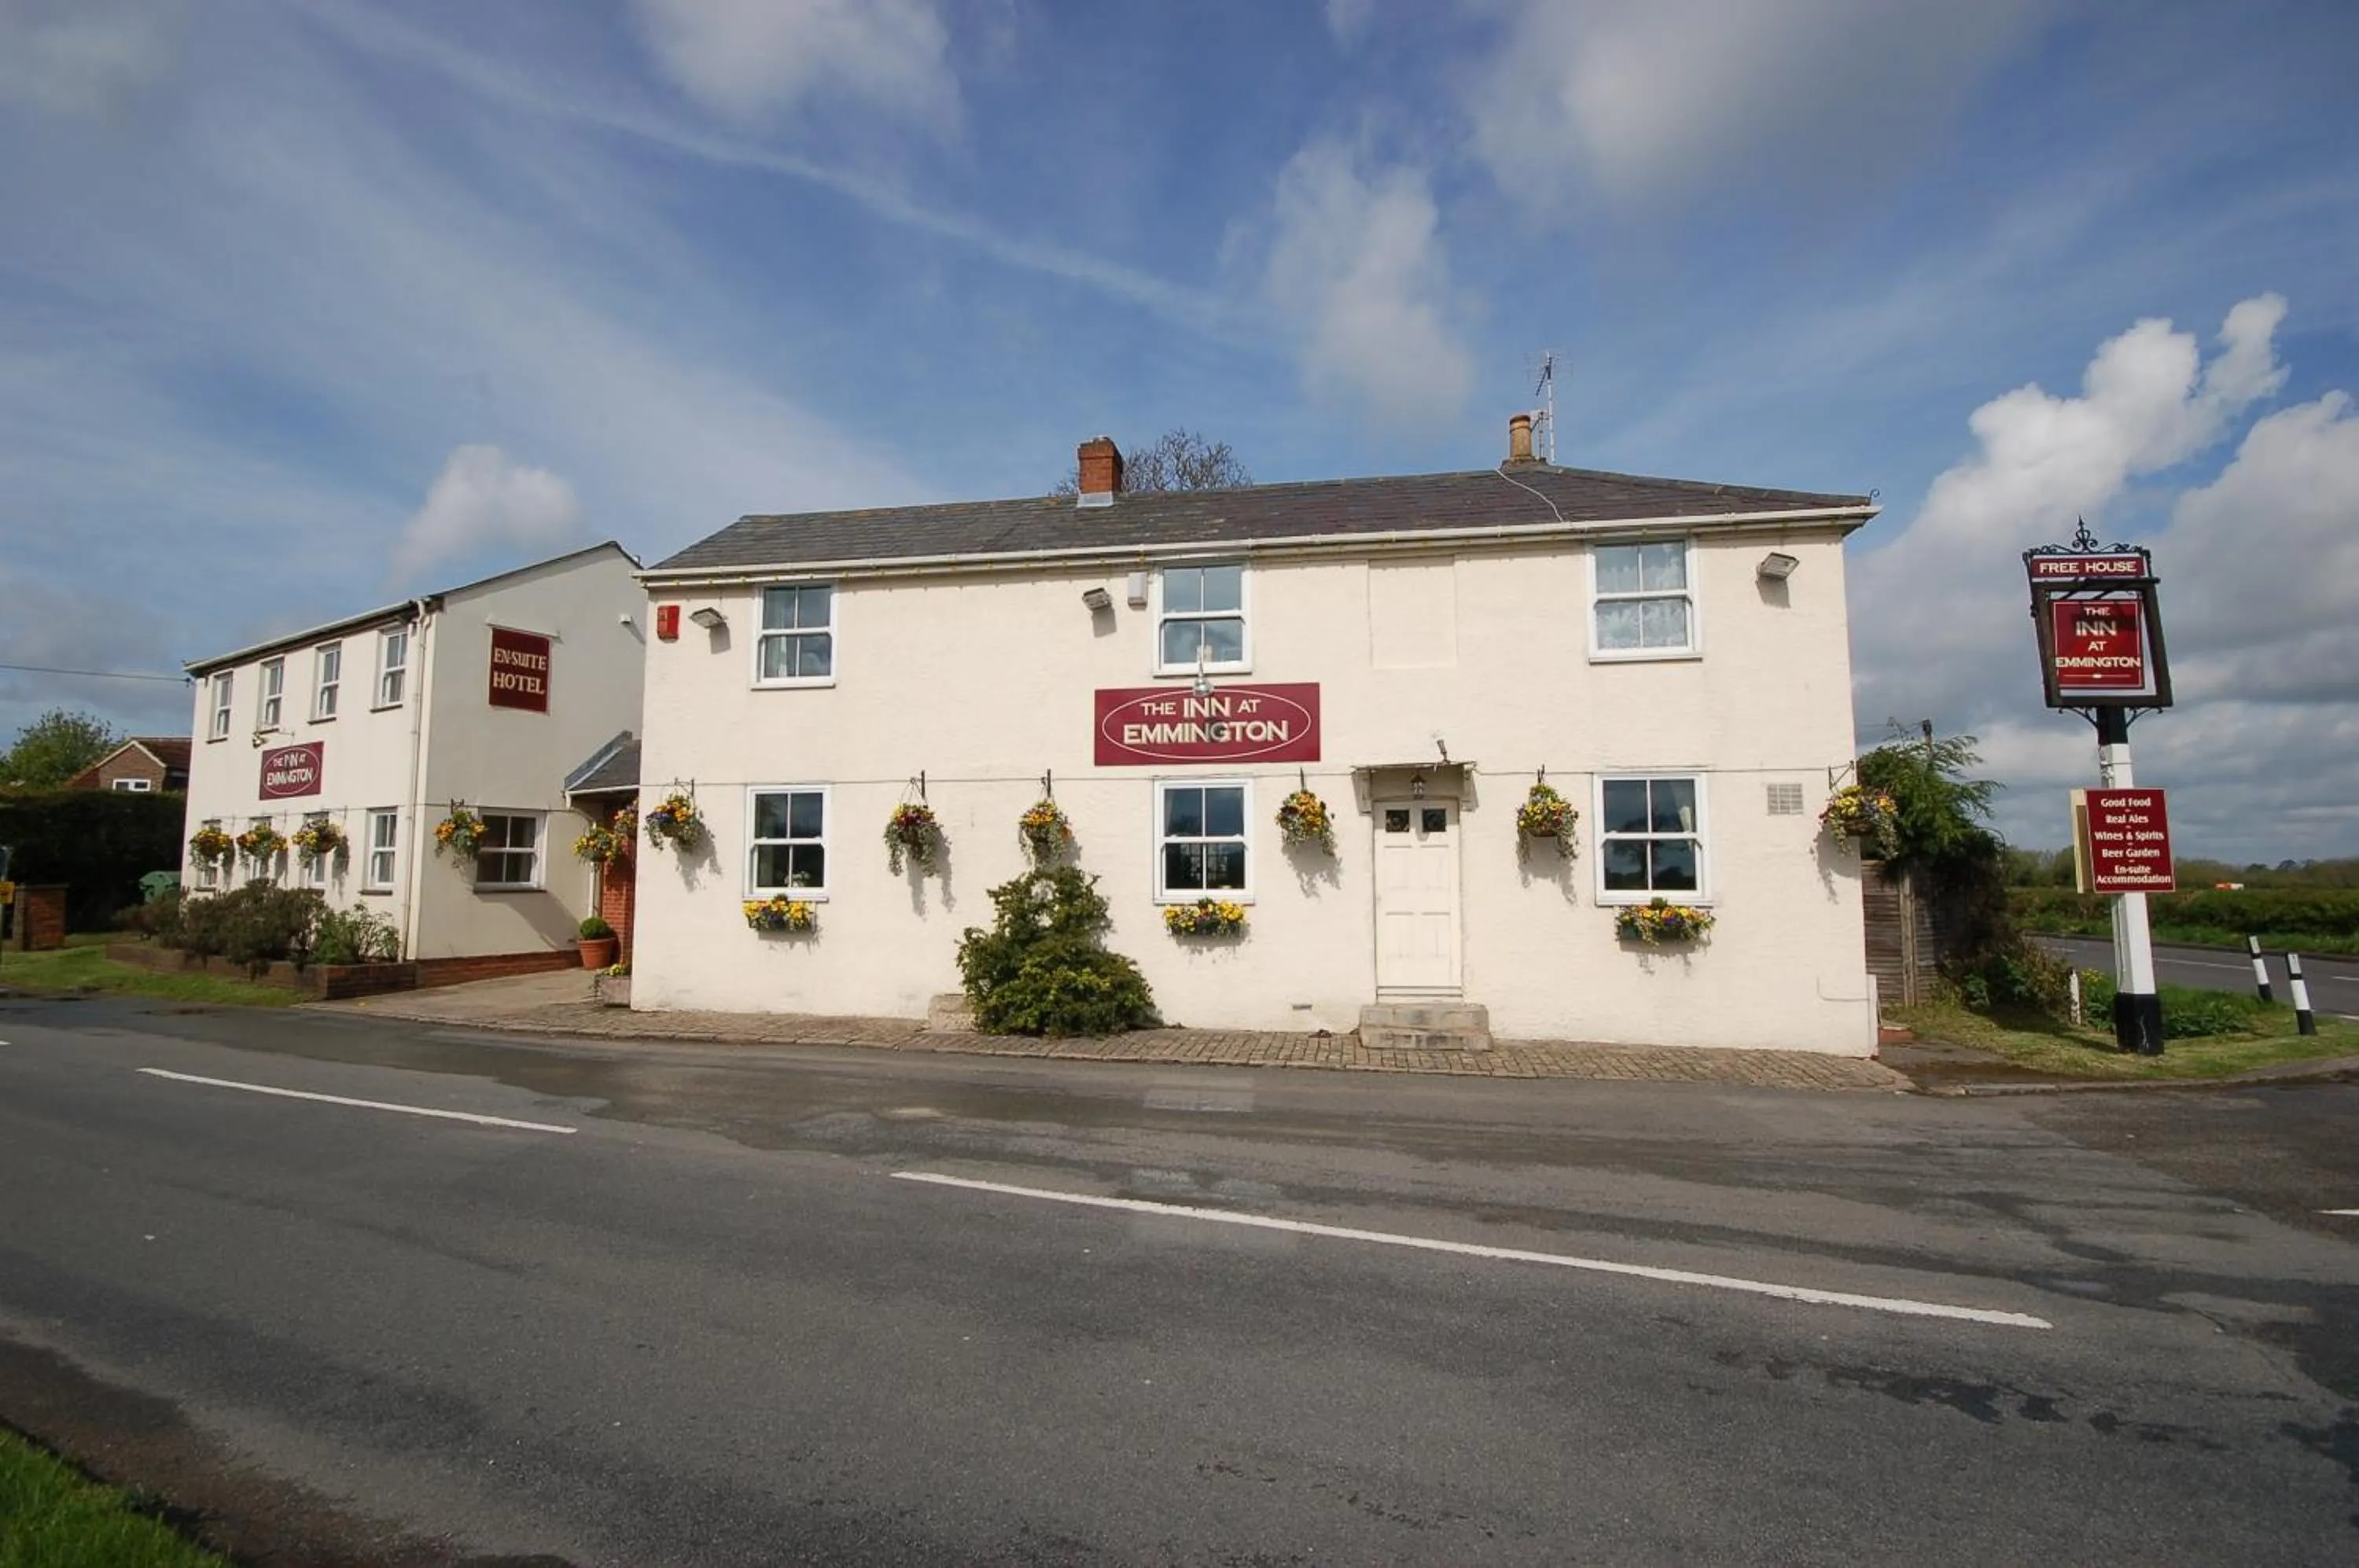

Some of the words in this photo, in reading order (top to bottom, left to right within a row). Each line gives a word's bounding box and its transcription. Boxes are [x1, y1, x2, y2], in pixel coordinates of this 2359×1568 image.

[2039, 561, 2079, 573] FREE
[2085, 561, 2136, 572] HOUSE
[2084, 606, 2111, 617] THE
[2076, 620, 2117, 636] INN
[2088, 641, 2107, 651] AT
[2055, 657, 2140, 668] EMMINGTON
[493, 671, 545, 694] HOTEL
[1141, 702, 1176, 716] THE
[1183, 697, 1231, 718] INN
[1237, 699, 1260, 713] AT
[1124, 720, 1289, 745] EMMINGTON
[2100, 797, 2125, 808] Good
[2105, 815, 2126, 824] Real
[2129, 814, 2149, 823] Ales
[2094, 832, 2123, 841] Wines
[2135, 831, 2164, 841] Spirits
[2102, 849, 2123, 858] Beer
[2125, 848, 2160, 857] Garden
[2096, 874, 2171, 884] Accommodation
